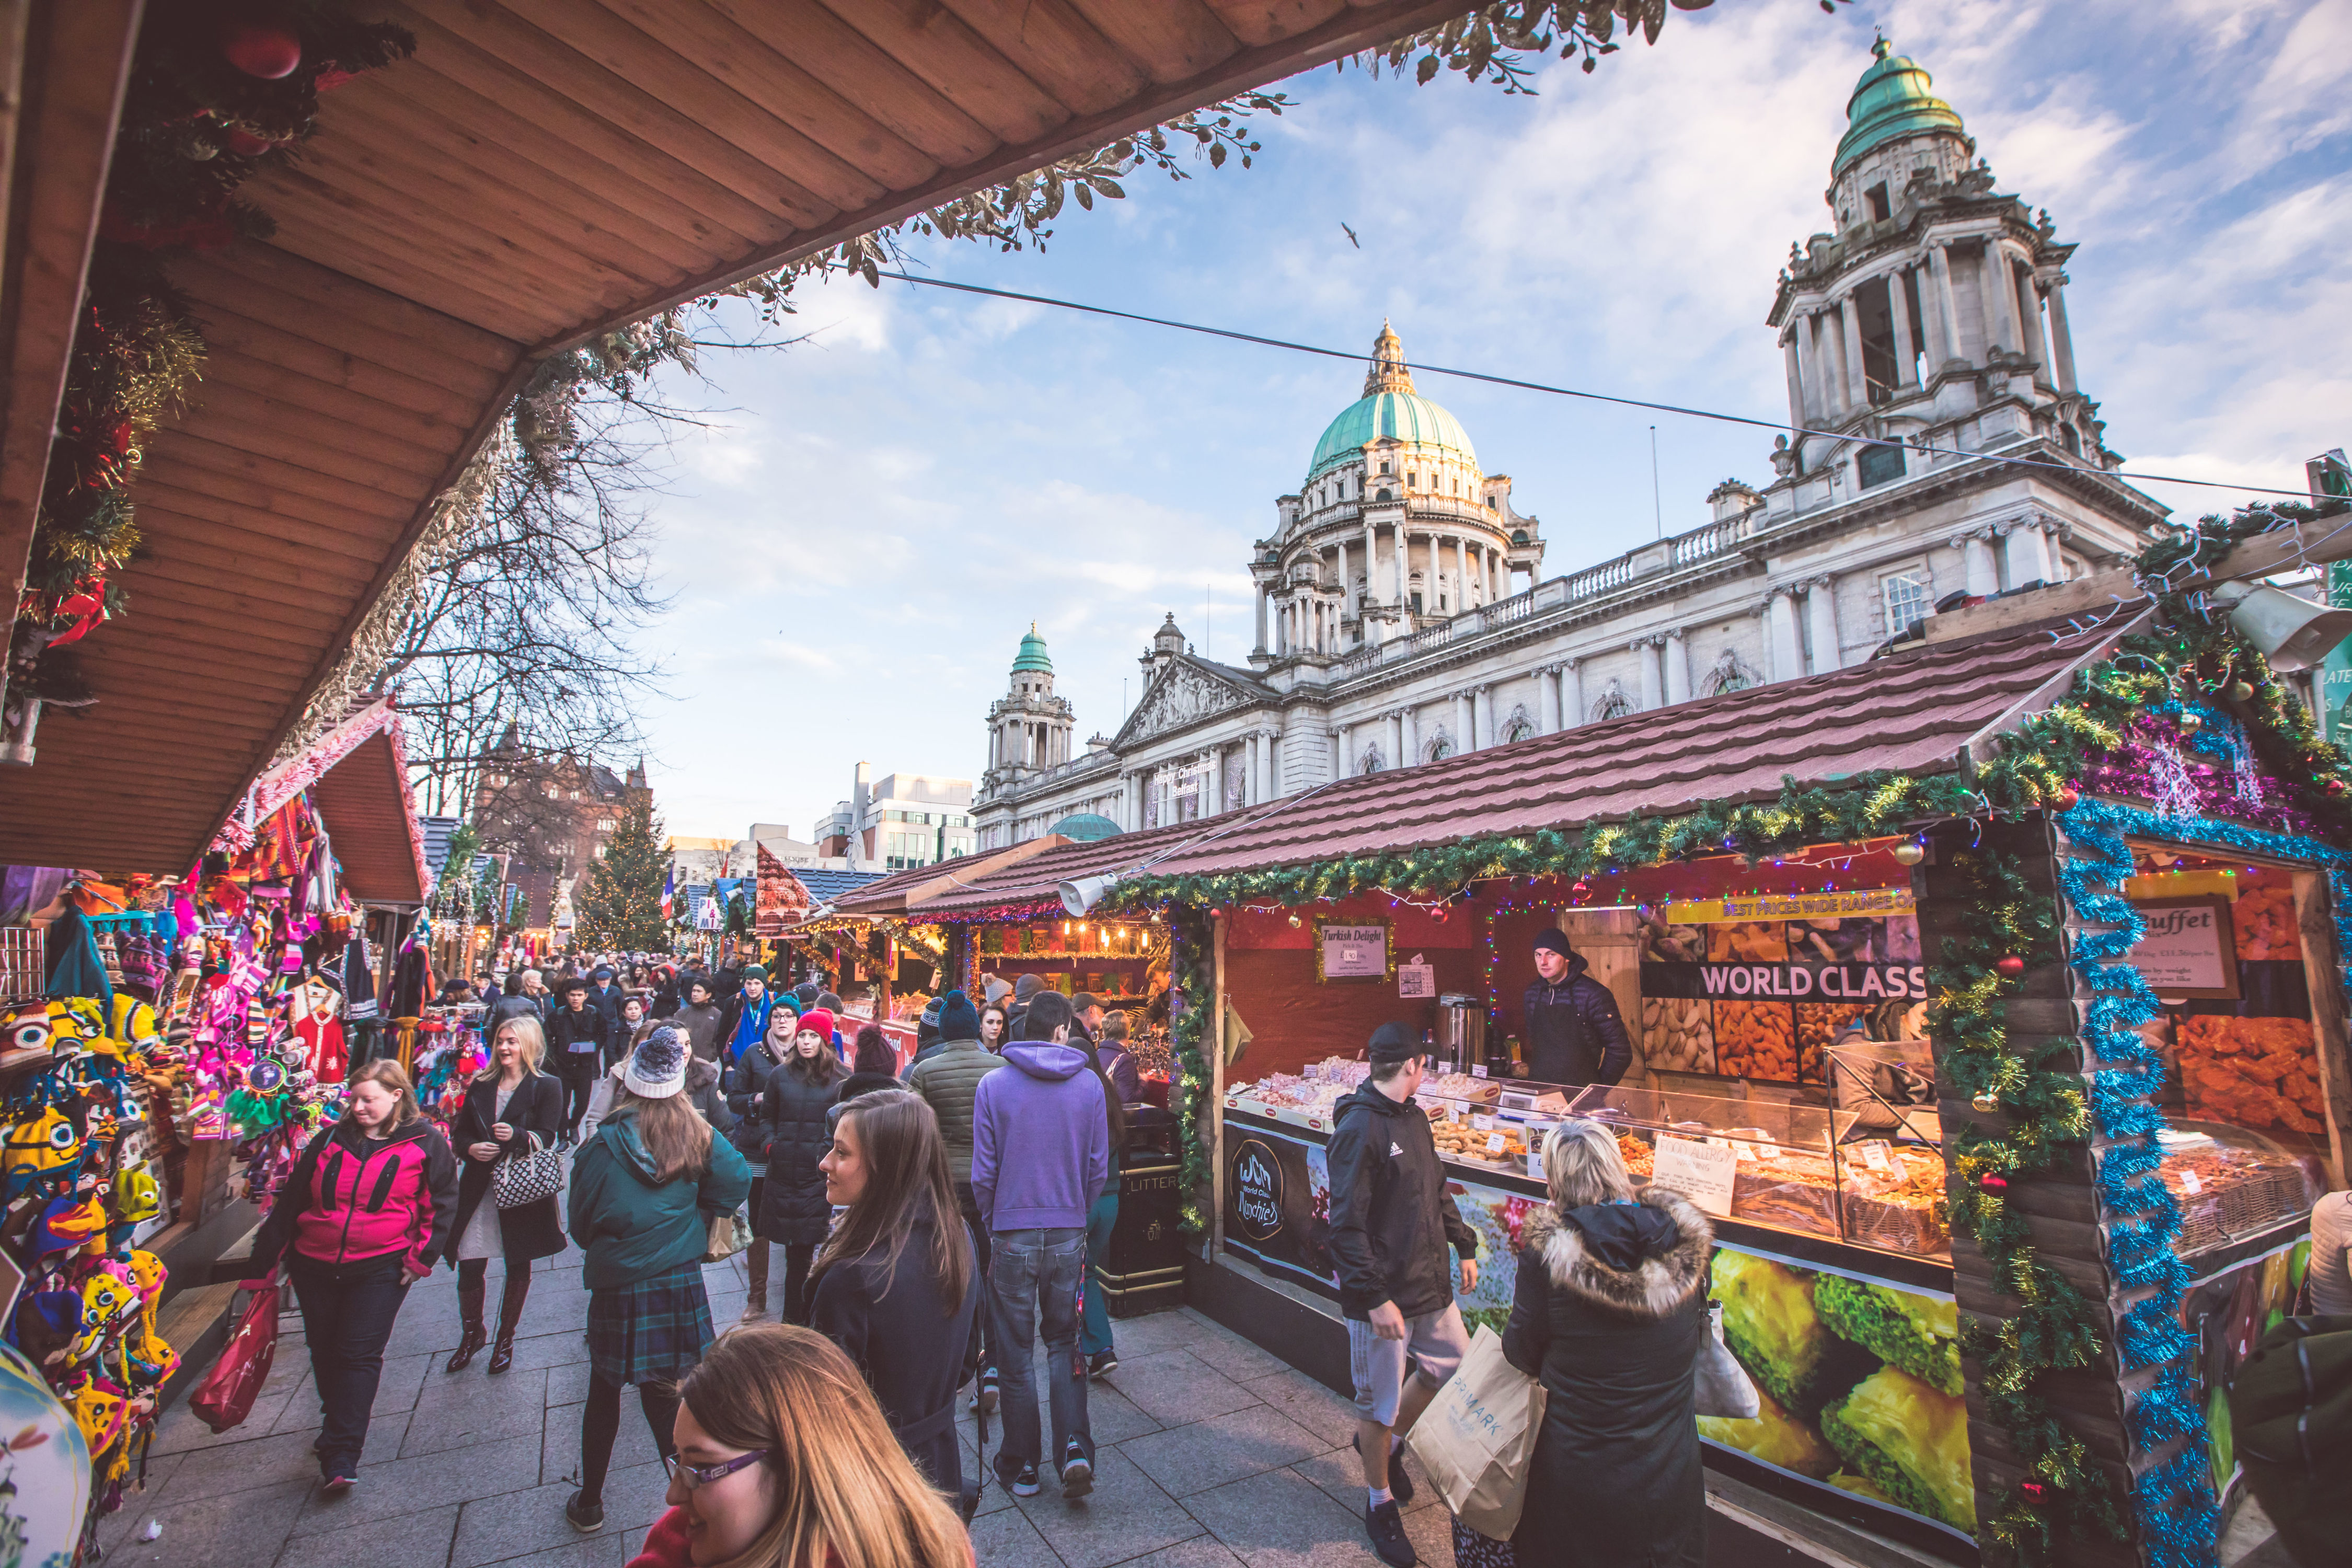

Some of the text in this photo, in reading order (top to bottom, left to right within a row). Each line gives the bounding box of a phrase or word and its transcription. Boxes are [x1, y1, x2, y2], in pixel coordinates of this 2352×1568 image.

[2323, 669, 2352, 685] ATE
[1154, 760, 1216, 786] Happy Christmas
[1172, 782, 1198, 797] Belfast
[709, 909, 716, 918] &
[1724, 904, 1753, 916] BEST
[1756, 901, 1800, 915] PRICES
[1802, 898, 1838, 913] WIDE
[1841, 896, 1893, 910] RANGE
[1323, 930, 1381, 944] Turkish Delight
[1700, 966, 1927, 999] WORLD CLASS
[1661, 1139, 1732, 1163] FOOD ALLERGY
[1239, 1154, 1271, 1192] WCM
[1676, 1157, 1710, 1172] WARNING
[1131, 1176, 1177, 1192] LITTER
[1243, 1185, 1258, 1195] World
[1238, 1191, 1278, 1227] Munchies
[1453, 1377, 1502, 1436] PRIMARK
